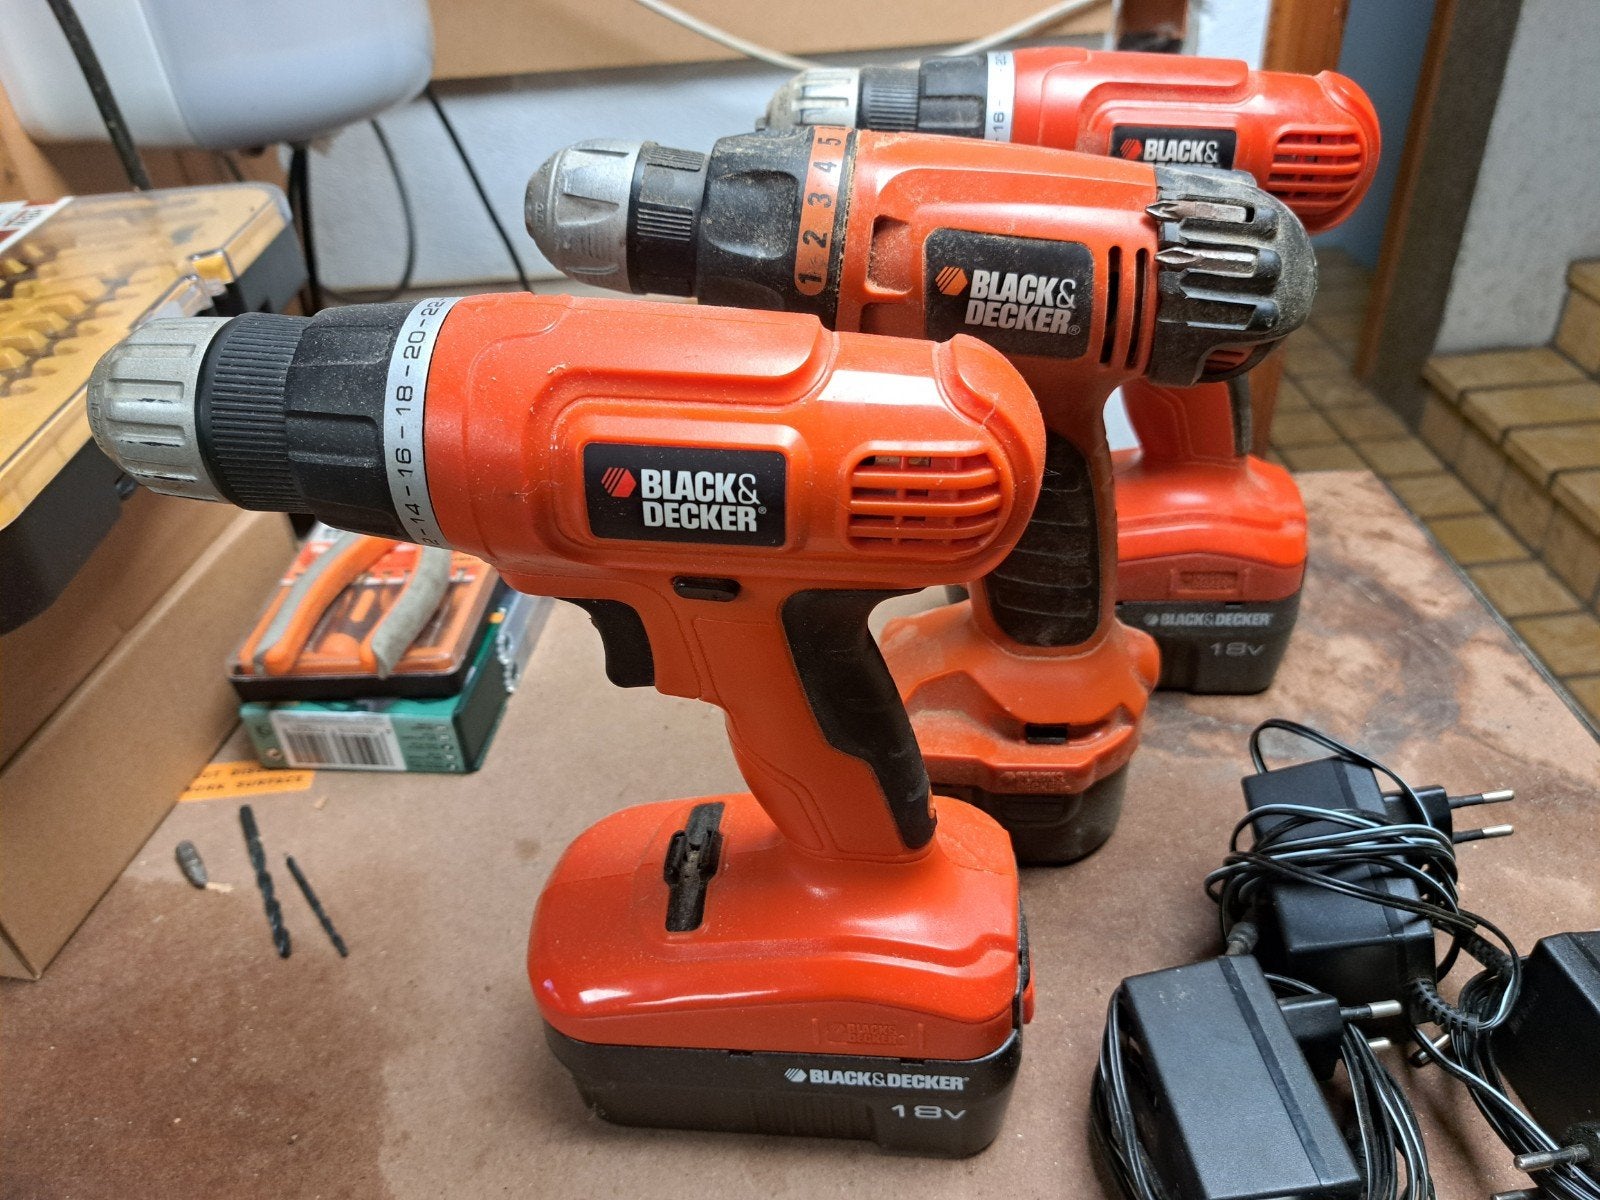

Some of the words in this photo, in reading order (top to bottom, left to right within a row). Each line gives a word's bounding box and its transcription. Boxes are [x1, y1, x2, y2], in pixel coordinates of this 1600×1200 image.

[817, 138, 841, 146] 5
[1143, 138, 1218, 163] BLACK&
[813, 161, 837, 173] 4
[808, 193, 832, 209] 3
[803, 230, 827, 248] 2
[799, 274, 822, 284] 1
[970, 269, 1076, 309] BLACK&
[641, 468, 761, 505] BLACK&
